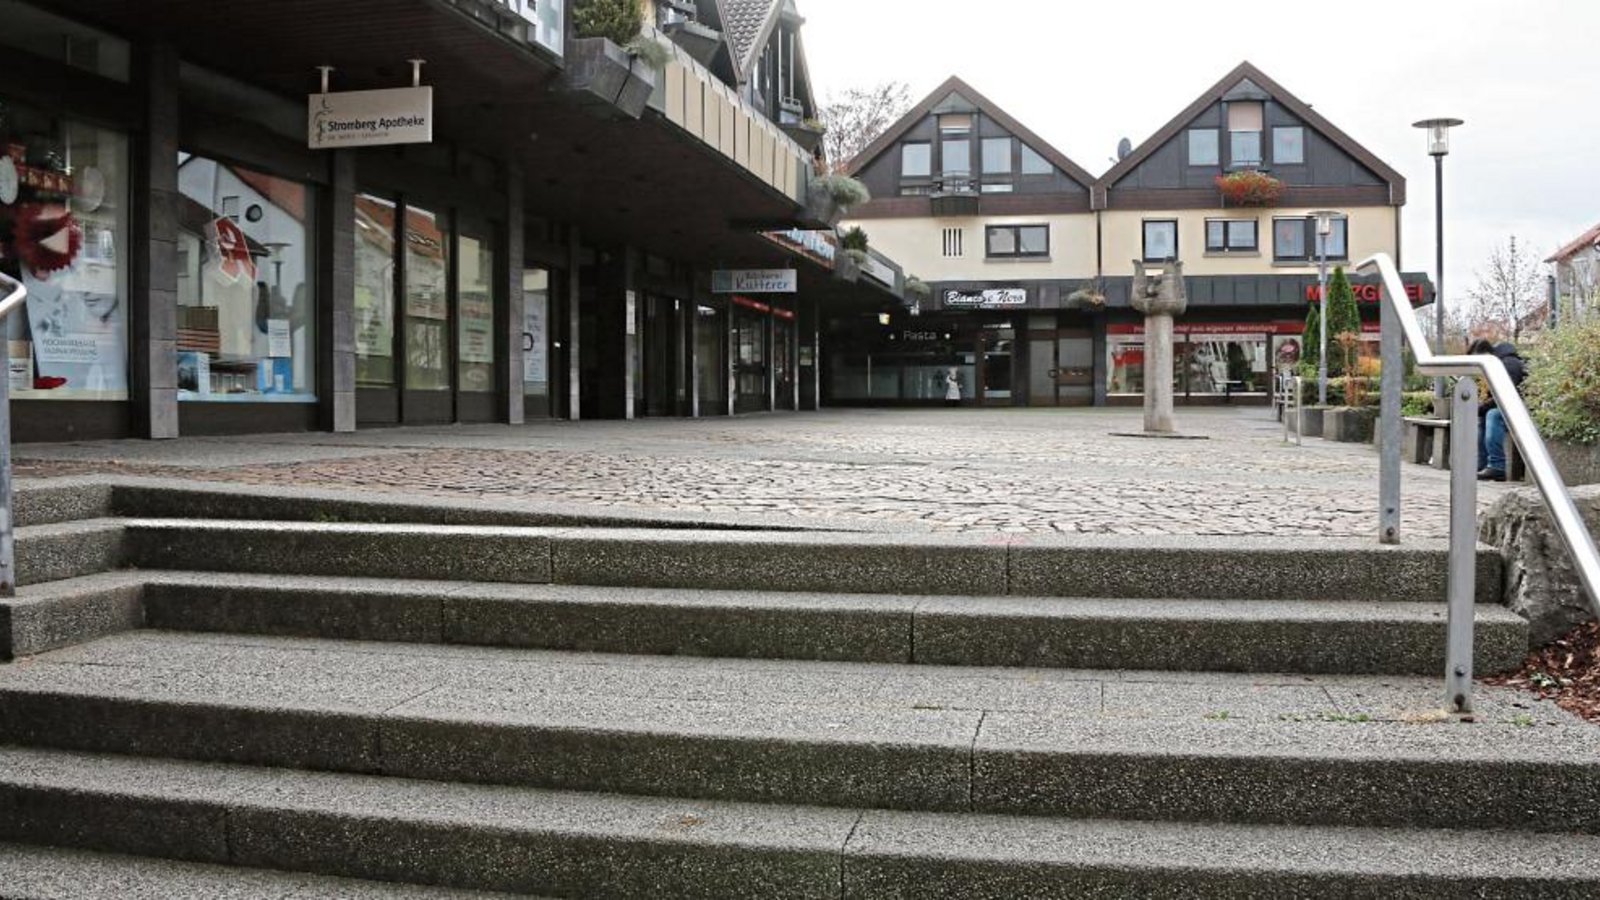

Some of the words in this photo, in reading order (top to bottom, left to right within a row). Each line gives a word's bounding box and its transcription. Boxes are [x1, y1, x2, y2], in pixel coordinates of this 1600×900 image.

[327, 118, 377, 132] Stromberg
[379, 115, 425, 130] Apotheke
[947, 291, 984, 303] Bianco
[997, 289, 1025, 303] Nero
[1306, 284, 1424, 302] MZGEI
[903, 330, 938, 341] Pasta
